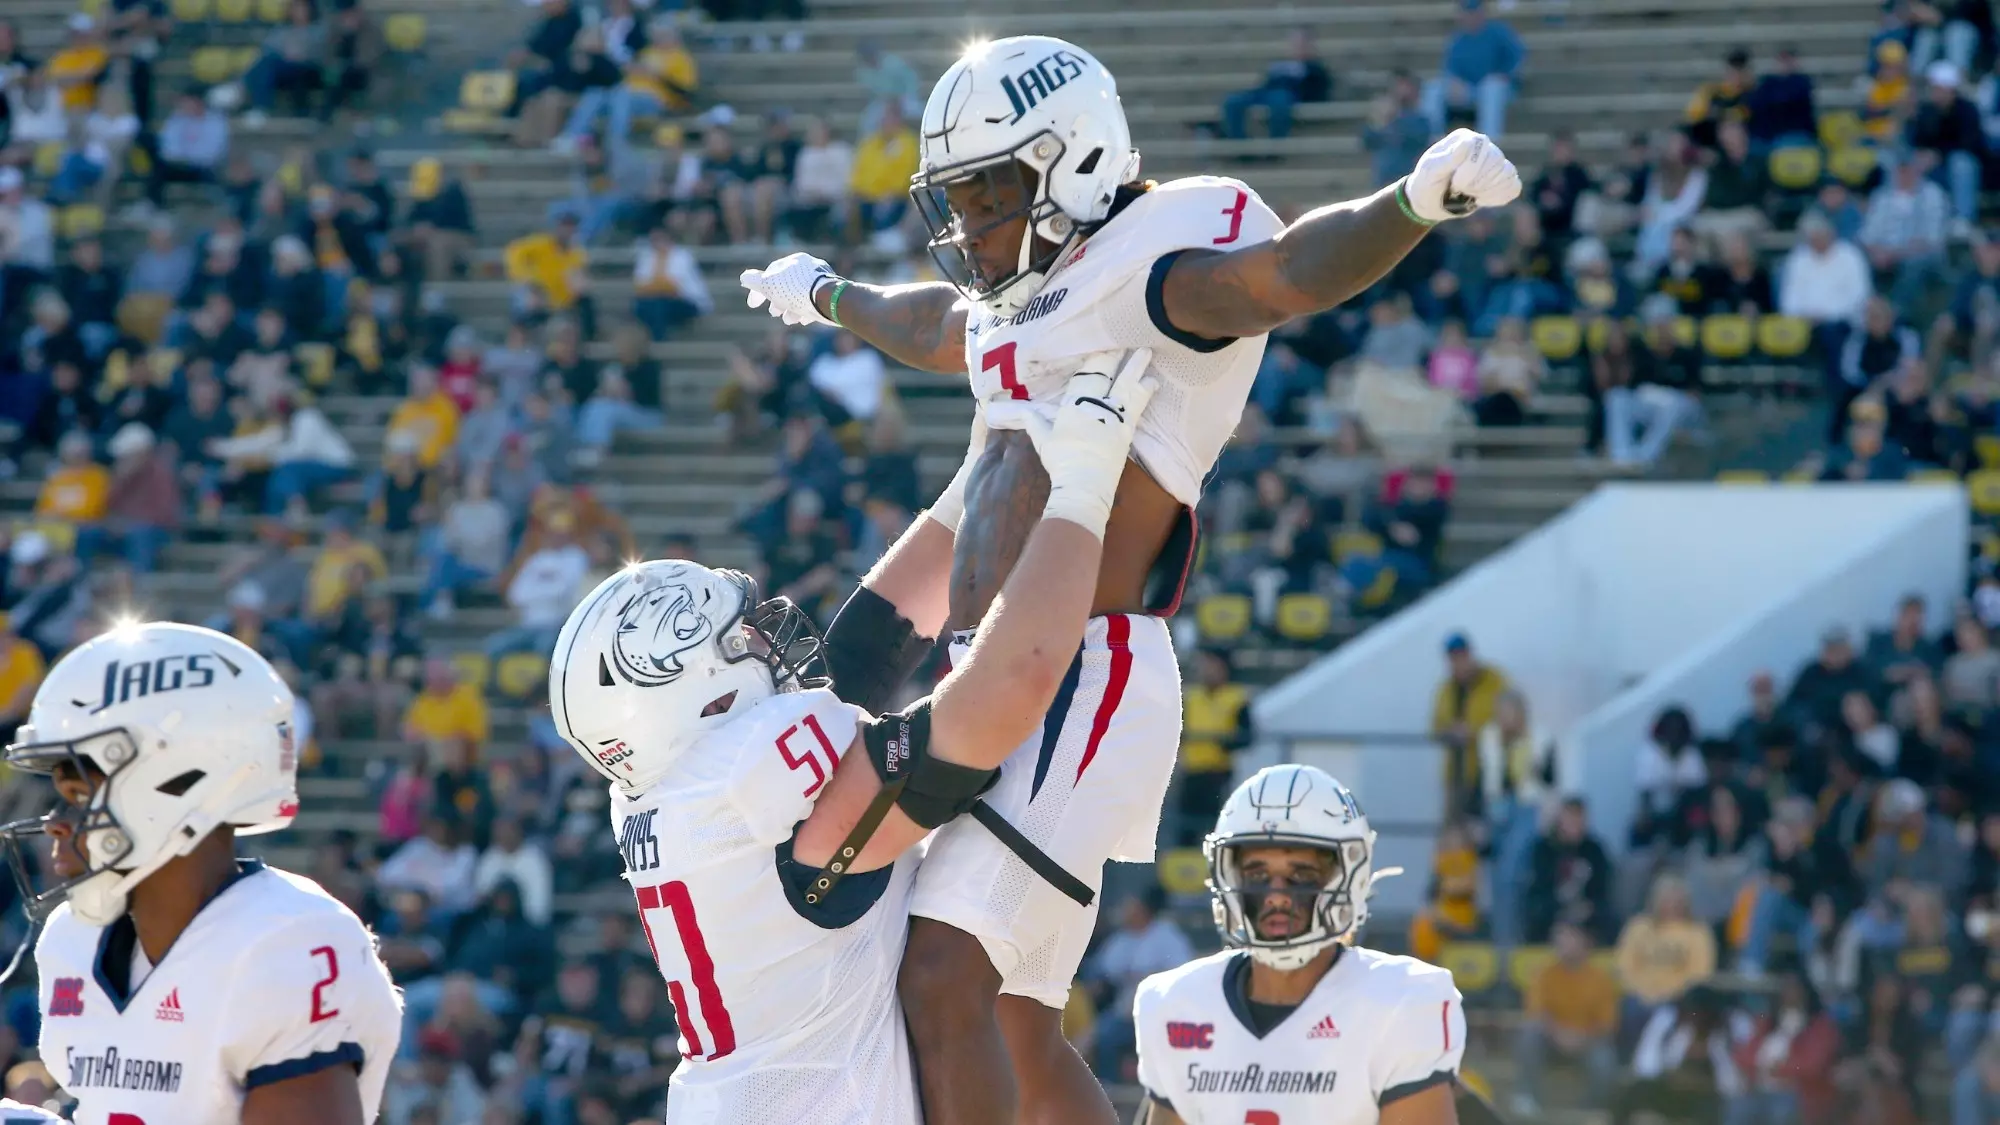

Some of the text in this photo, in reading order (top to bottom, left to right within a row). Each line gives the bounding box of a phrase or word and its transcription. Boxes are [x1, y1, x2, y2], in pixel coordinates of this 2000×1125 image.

[1000, 50, 1083, 126] JAGS
[1213, 186, 1248, 245] 3
[89, 653, 214, 715] JAGS
[775, 713, 840, 798] 51
[886, 740, 899, 772] PRO
[899, 721, 910, 759] GEAR
[309, 945, 339, 1024] 2
